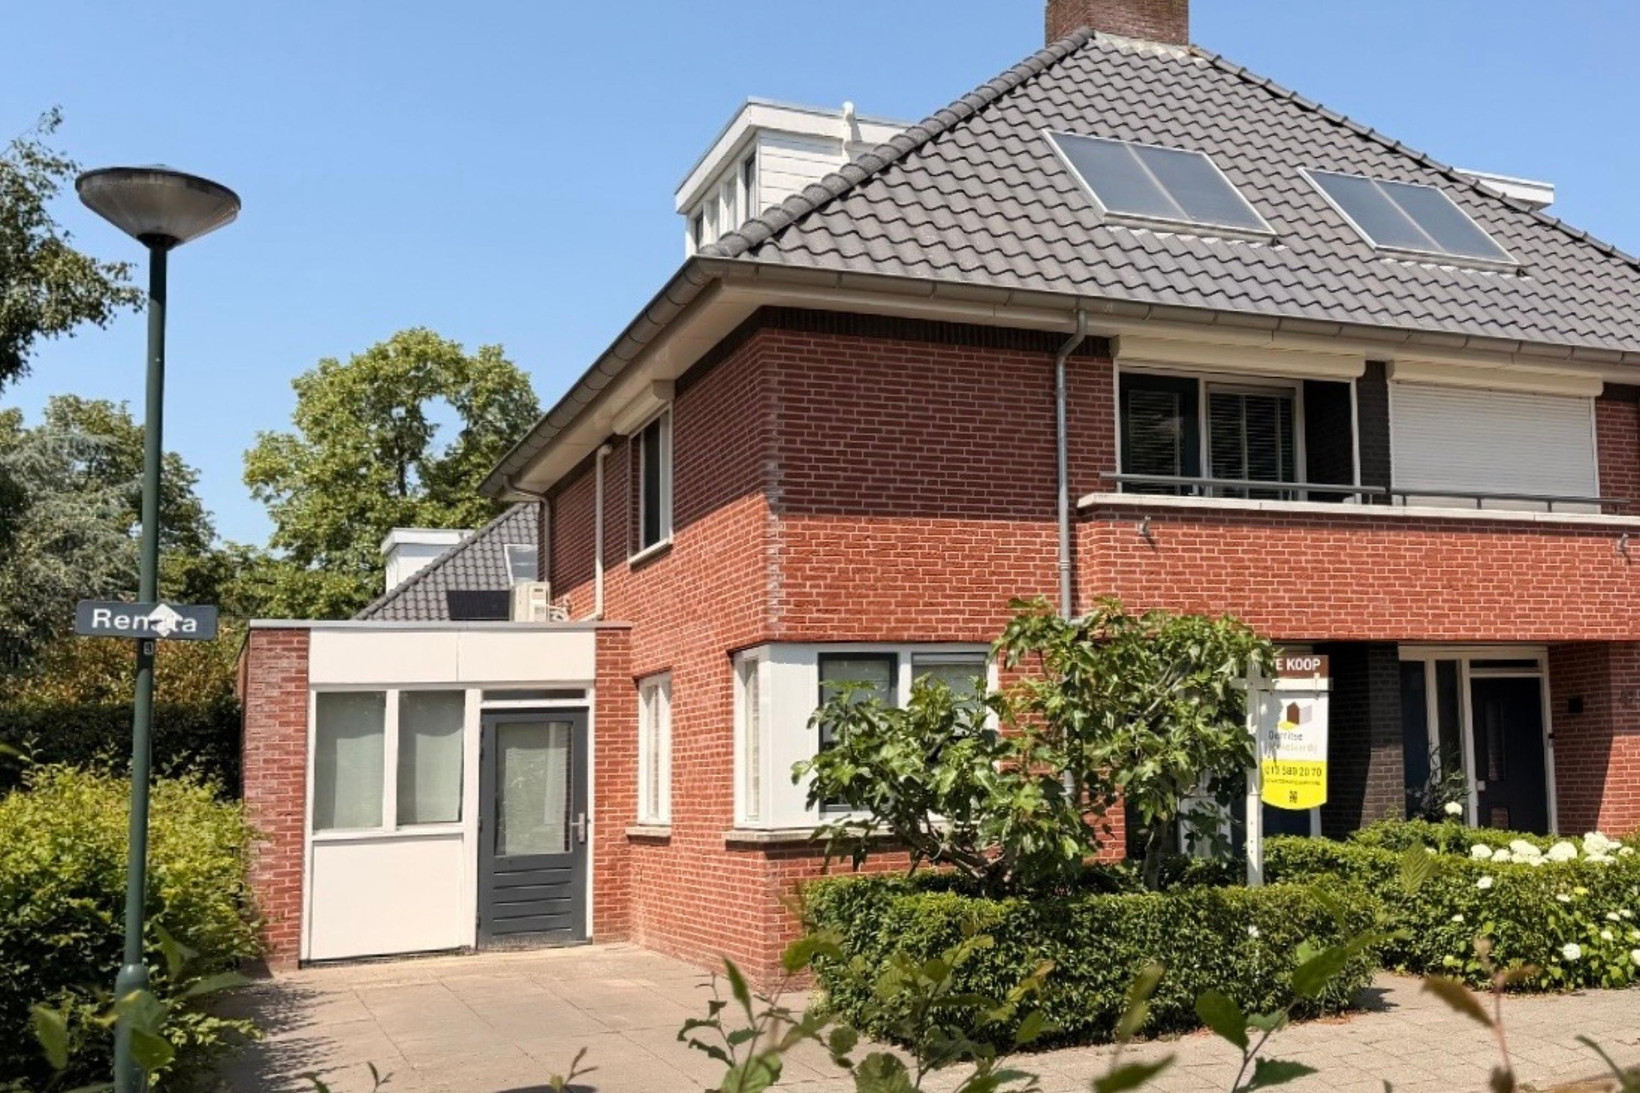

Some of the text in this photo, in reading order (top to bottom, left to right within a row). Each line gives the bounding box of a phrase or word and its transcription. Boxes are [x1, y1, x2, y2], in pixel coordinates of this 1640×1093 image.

[1286, 657, 1321, 671] KOOP
[1299, 766, 1310, 777] 20
[1311, 766, 1322, 777] 70
